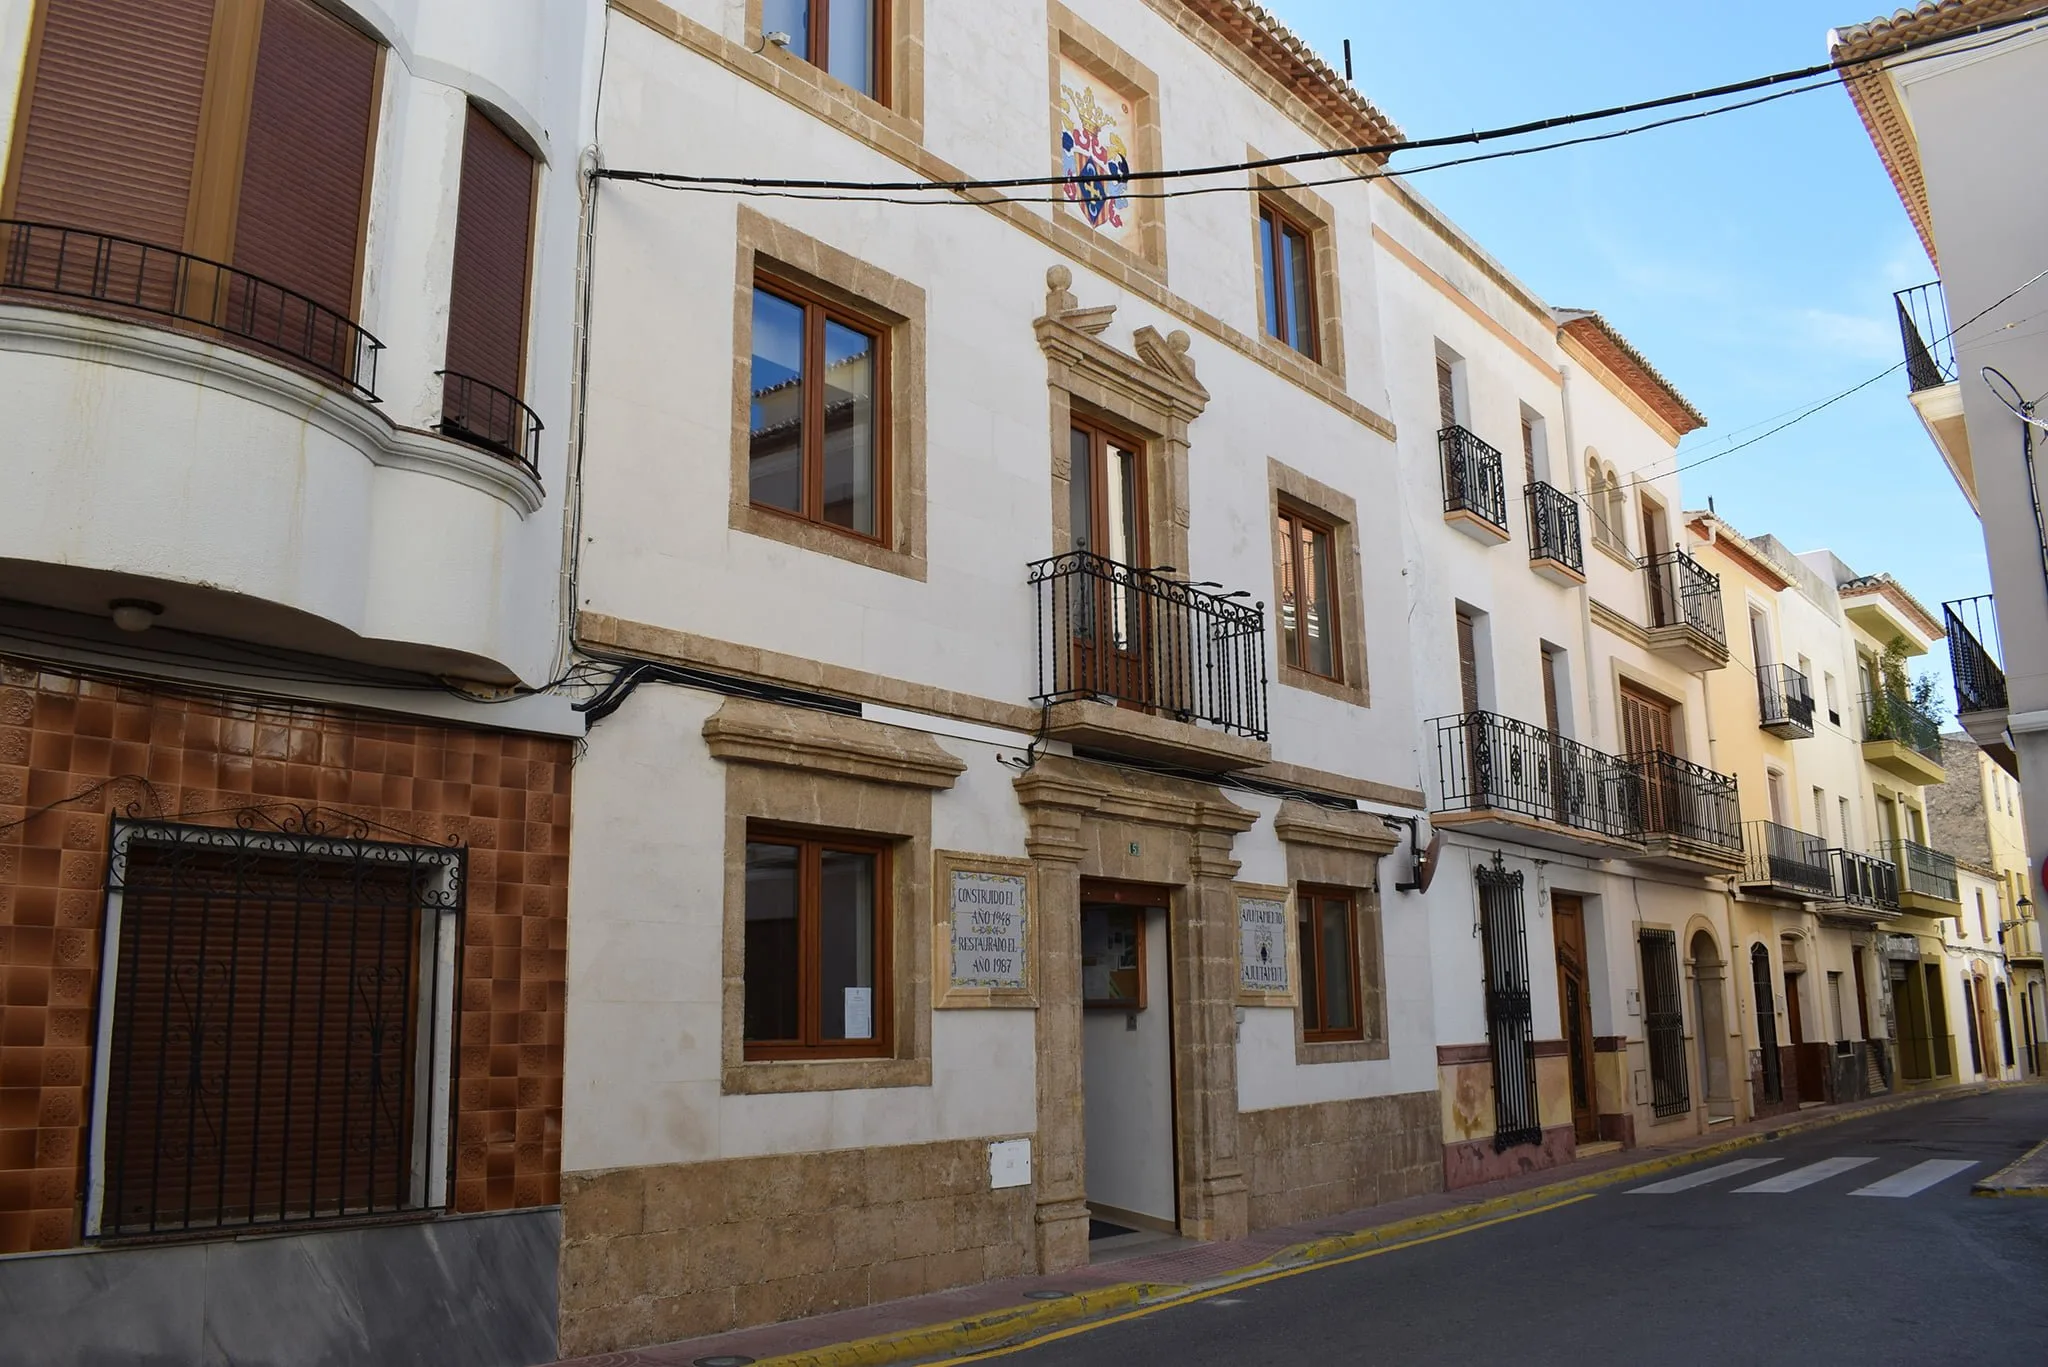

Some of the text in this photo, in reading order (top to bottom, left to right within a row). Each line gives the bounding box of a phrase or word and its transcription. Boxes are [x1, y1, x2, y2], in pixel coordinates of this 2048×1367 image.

[958, 888, 1015, 906] CONSTRUIDO EL
[971, 908, 1011, 927] AÑO 1948
[958, 936, 1017, 953] RESTAURADO EL
[972, 956, 1012, 973] AÑO 1987
